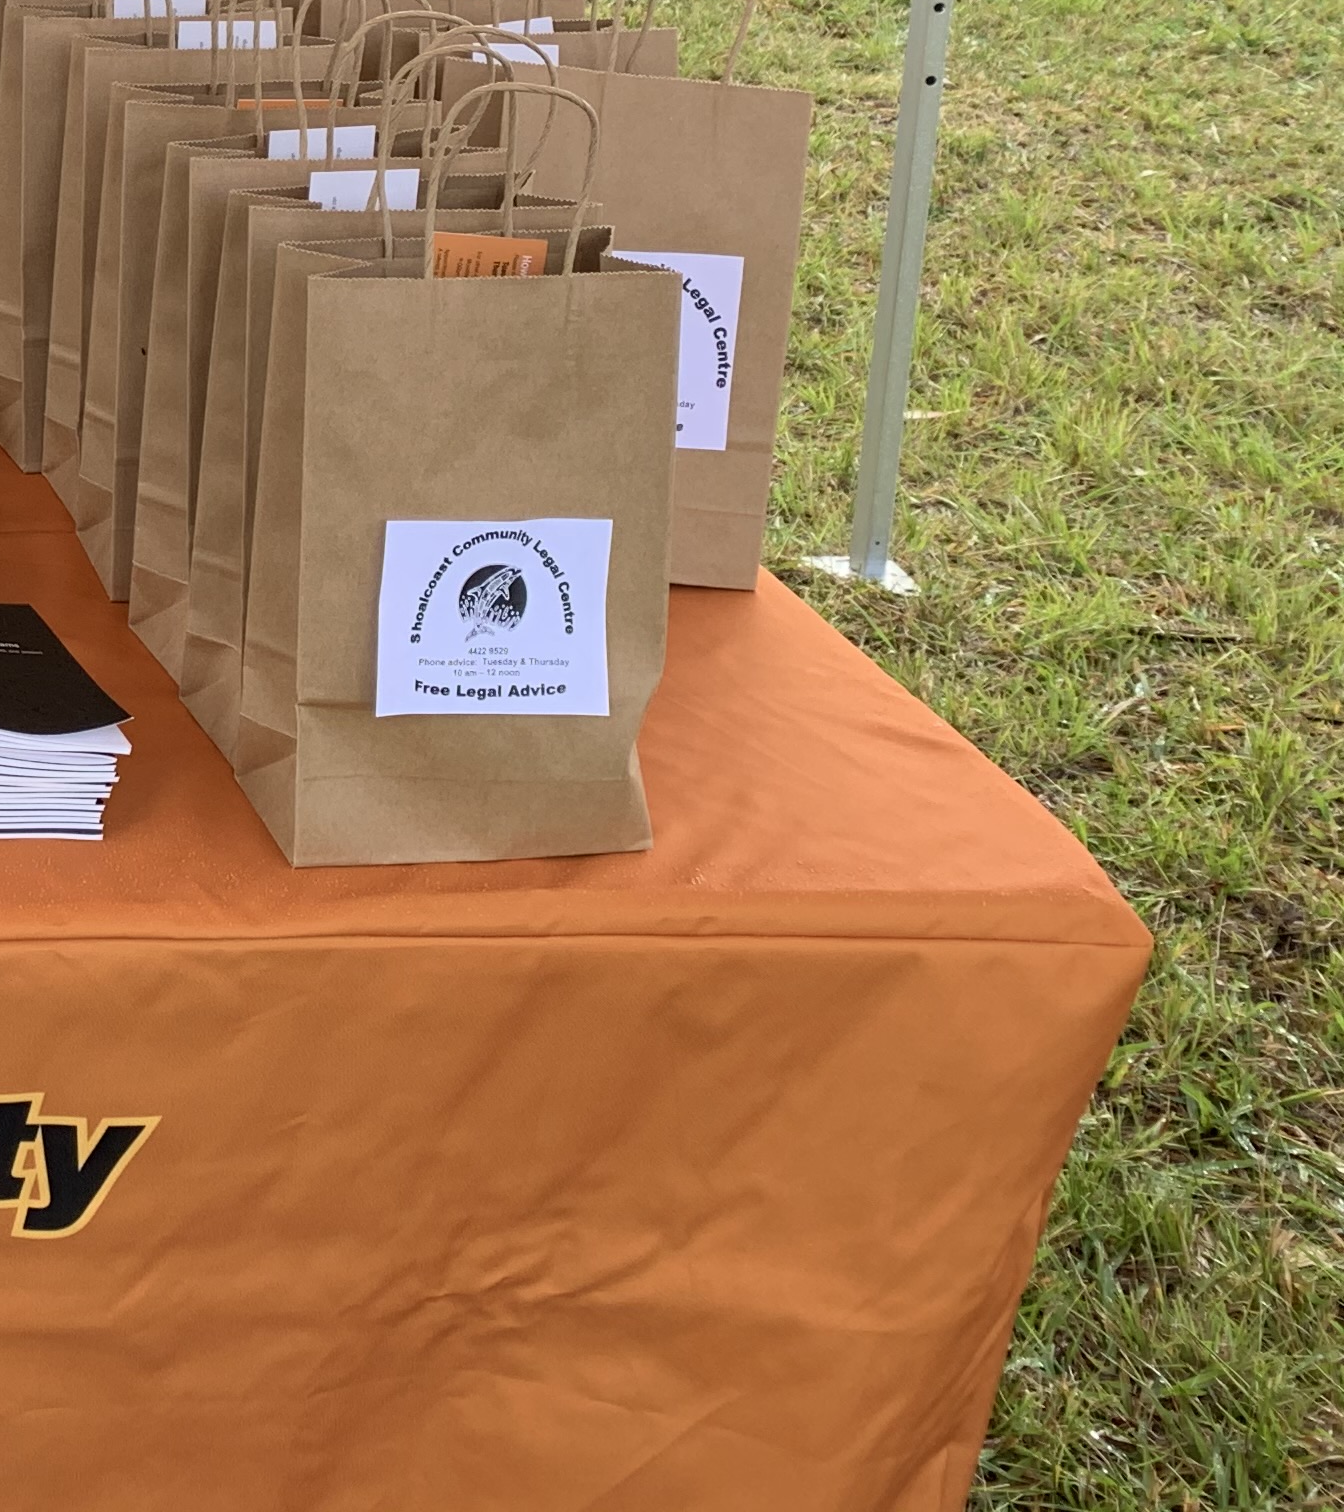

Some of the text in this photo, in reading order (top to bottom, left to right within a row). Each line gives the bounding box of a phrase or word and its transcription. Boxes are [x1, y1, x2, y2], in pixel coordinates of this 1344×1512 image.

[682, 277, 731, 389] Legal Centre
[410, 529, 575, 644] Shoalcoast Community Legal Centre
[414, 679, 566, 700] Free Legal Advice
[418, 658, 570, 668] Phone advice: Tuesday & Thursday
